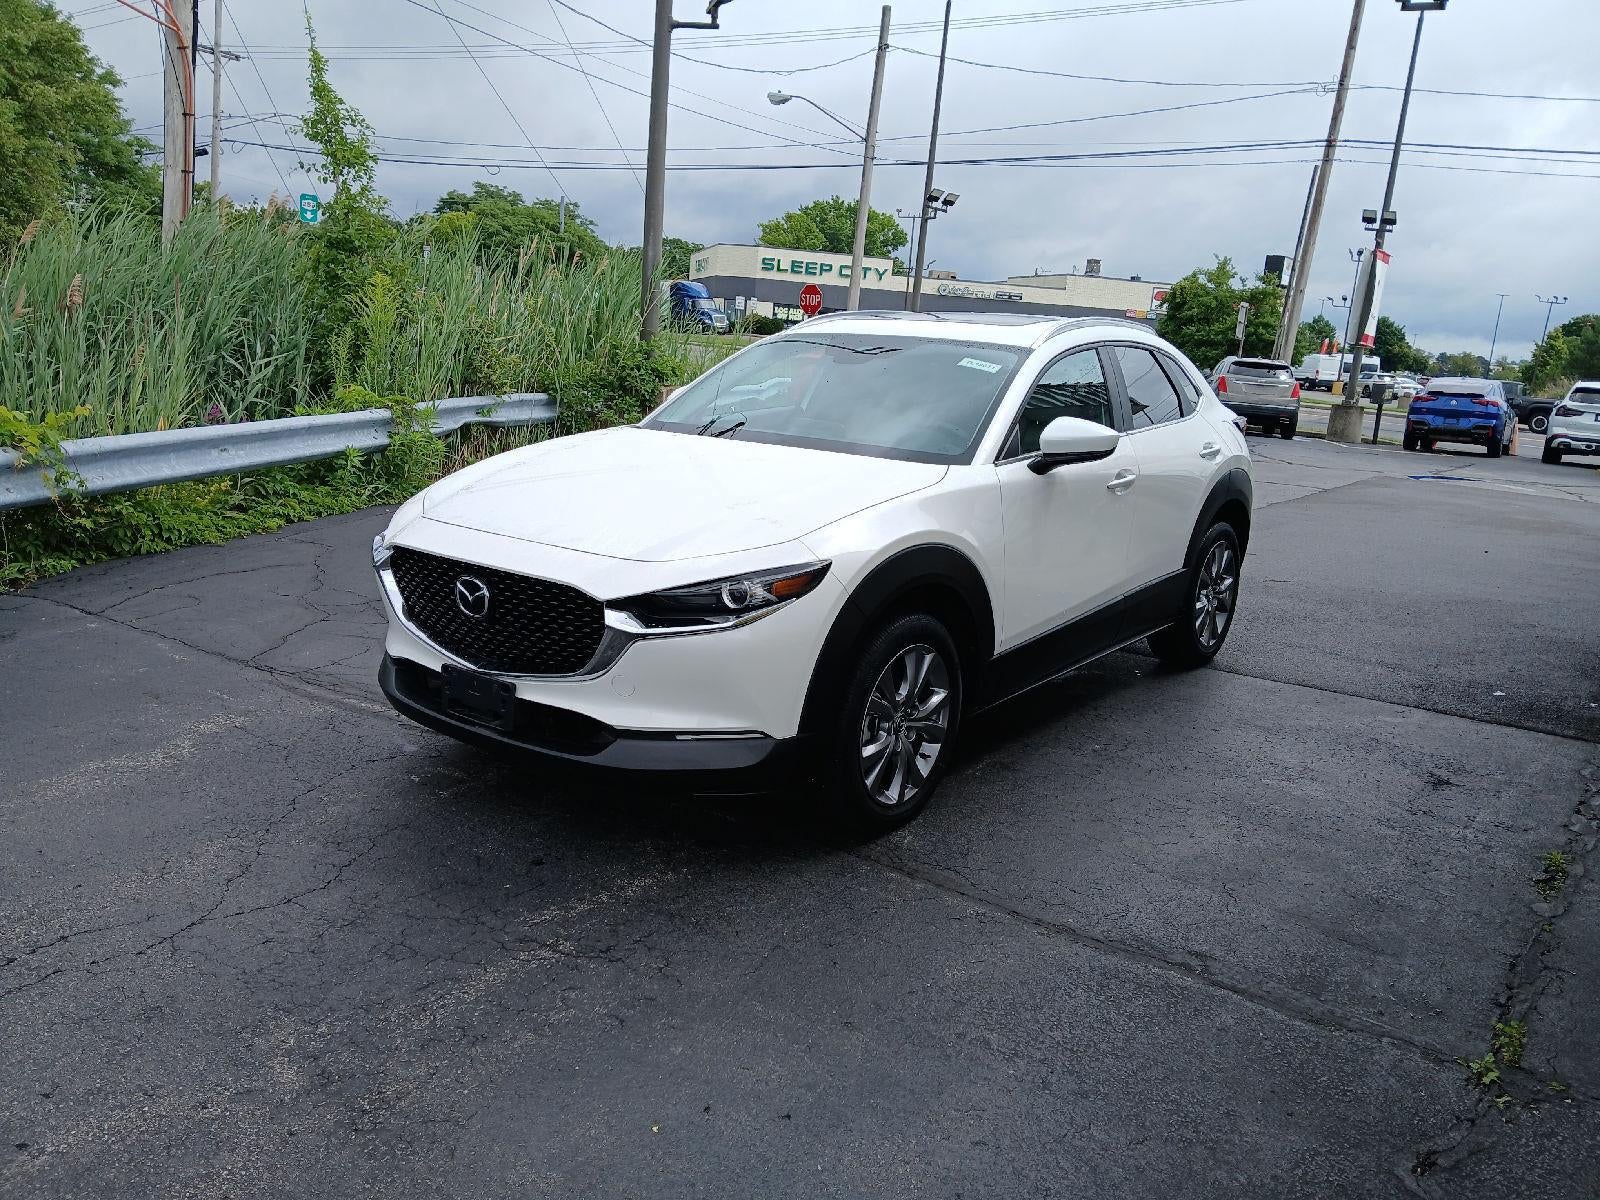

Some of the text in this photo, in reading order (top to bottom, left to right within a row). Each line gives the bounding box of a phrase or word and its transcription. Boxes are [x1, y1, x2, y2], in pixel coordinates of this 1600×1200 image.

[761, 257, 889, 281] SLEEP CTY
[800, 294, 821, 306] STOP
